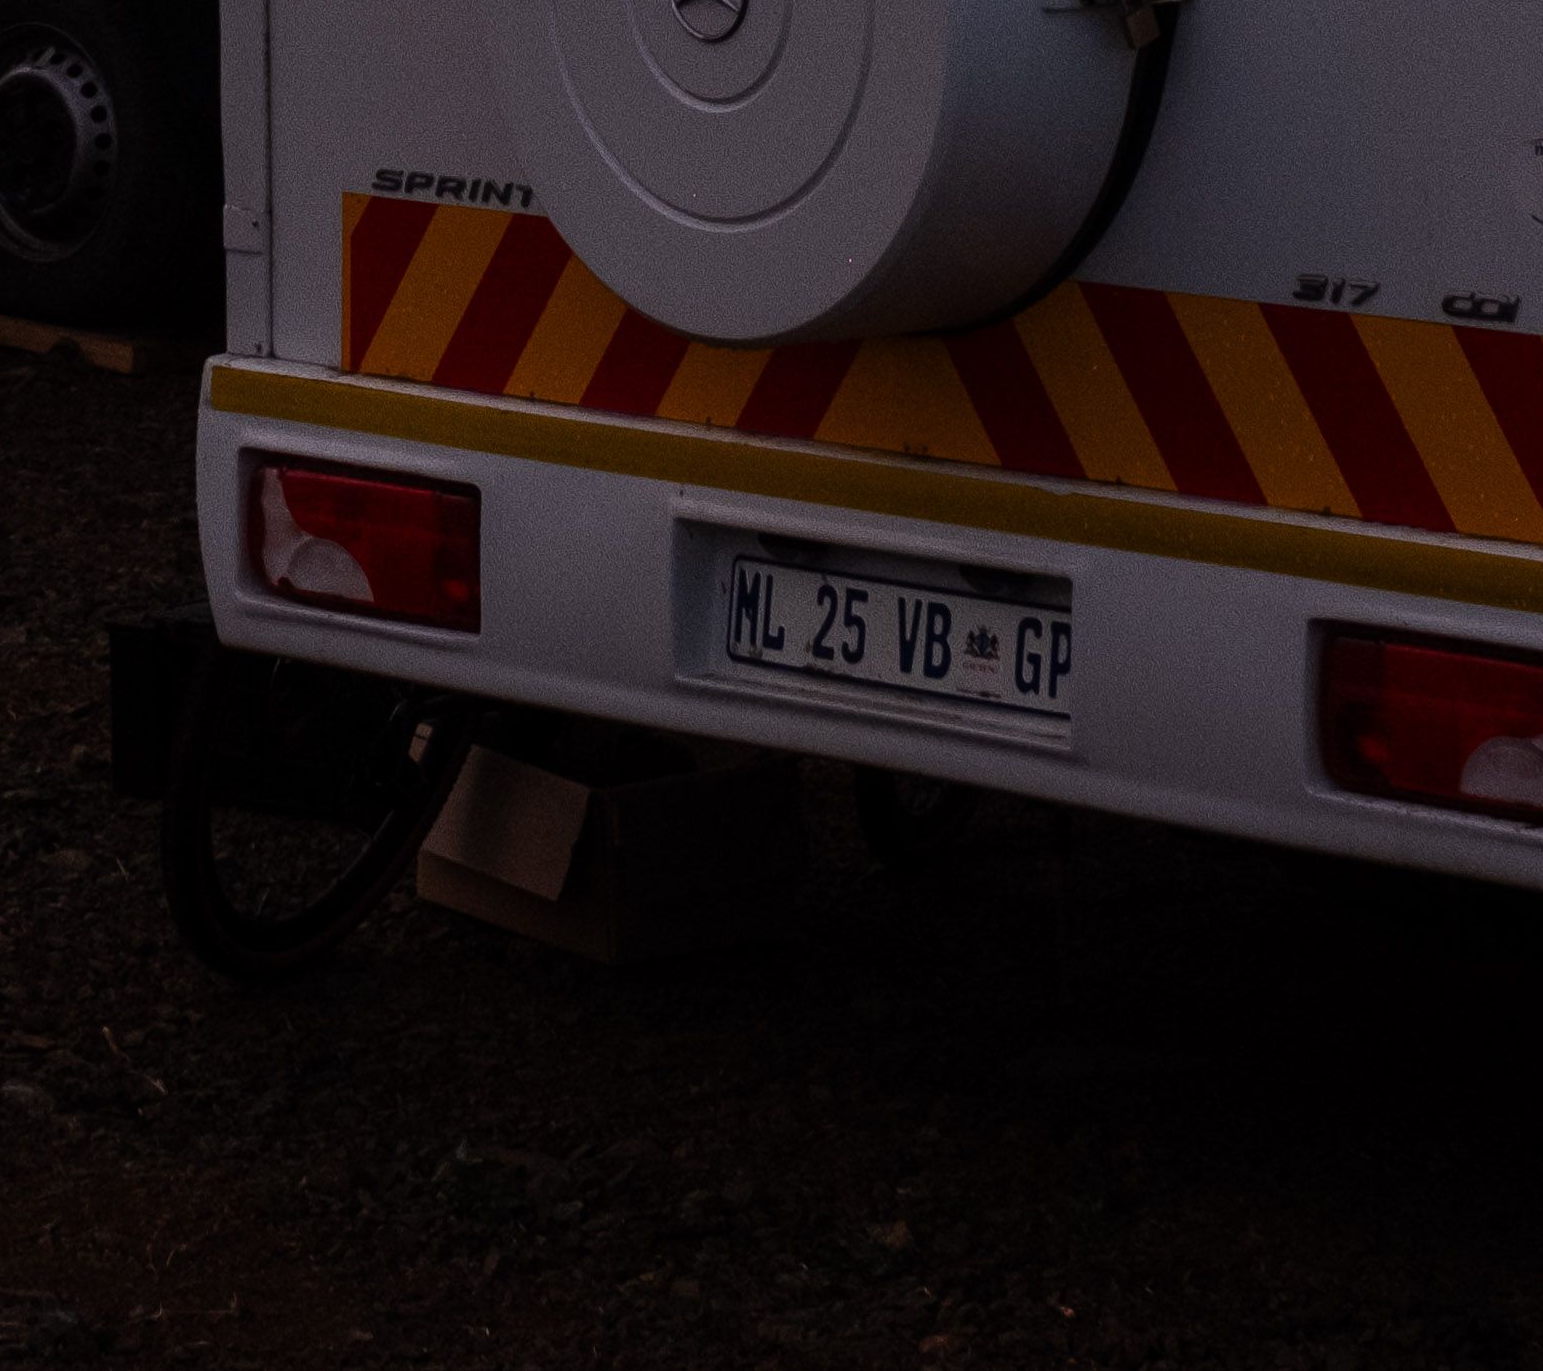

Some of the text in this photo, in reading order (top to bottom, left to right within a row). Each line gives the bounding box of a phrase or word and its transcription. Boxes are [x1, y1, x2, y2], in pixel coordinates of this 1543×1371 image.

[733, 569, 1073, 699] ML 25 VB GP
